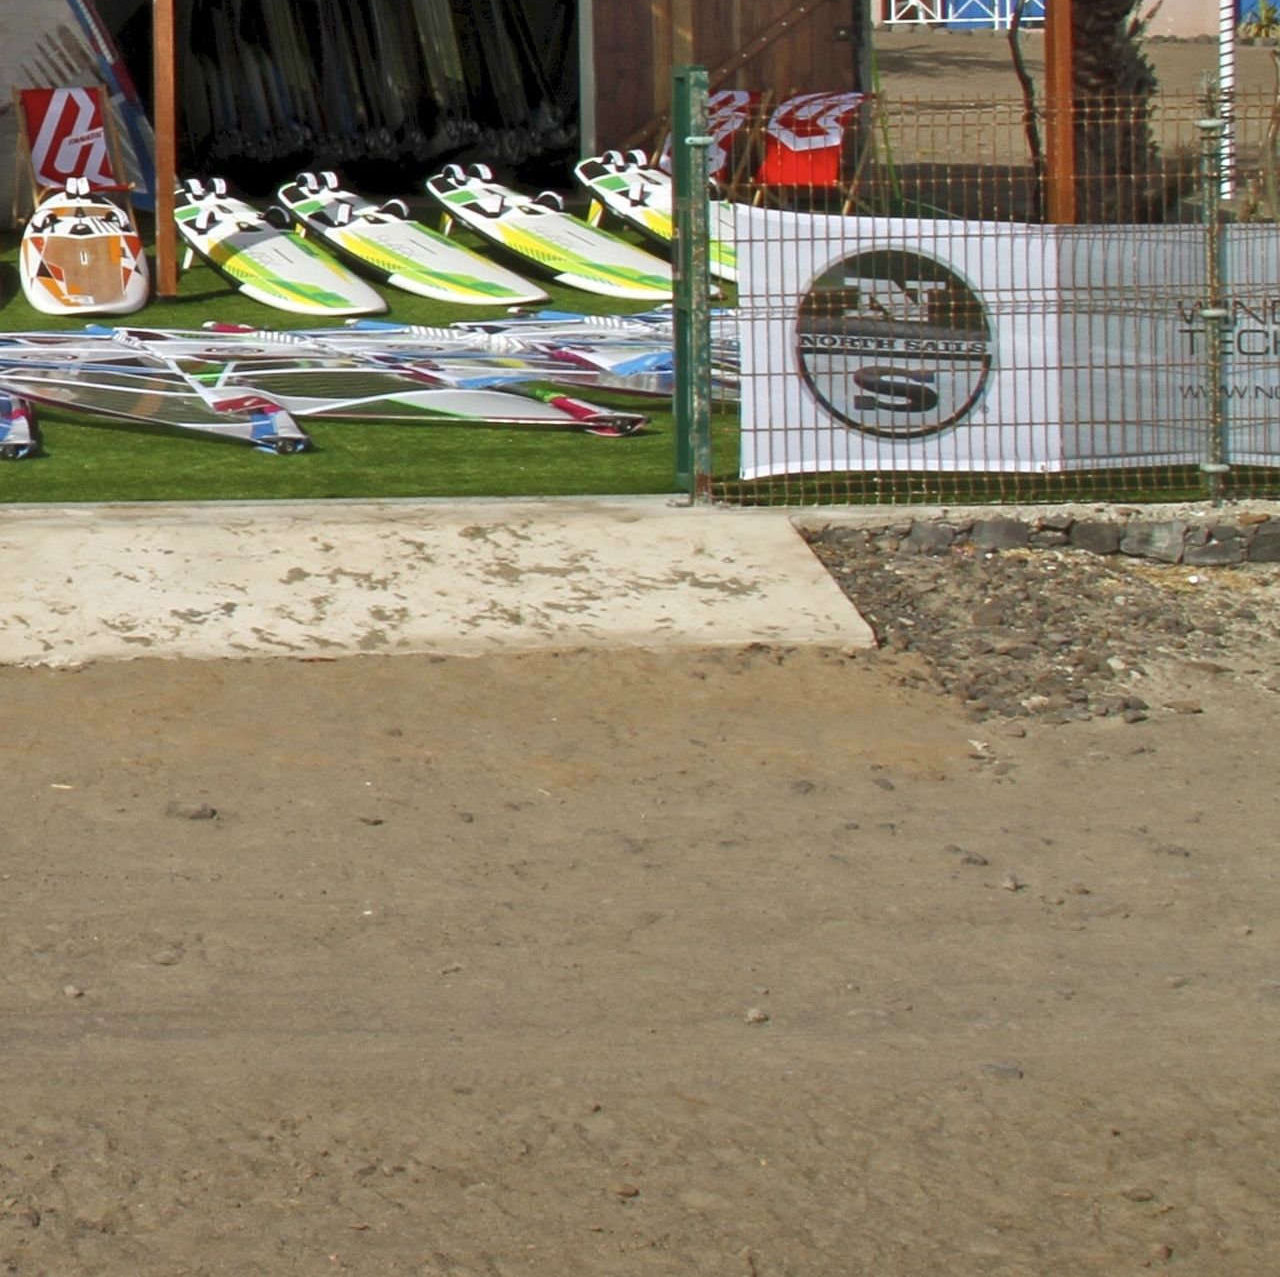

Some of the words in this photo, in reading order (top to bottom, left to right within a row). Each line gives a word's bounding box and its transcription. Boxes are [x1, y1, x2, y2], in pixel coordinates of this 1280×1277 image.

[67, 132, 104, 146] FANATIC
[1177, 299, 1280, 326] WIN
[798, 334, 897, 350] NORTH
[904, 339, 989, 354] SAILS
[1178, 328, 1280, 356] TEC
